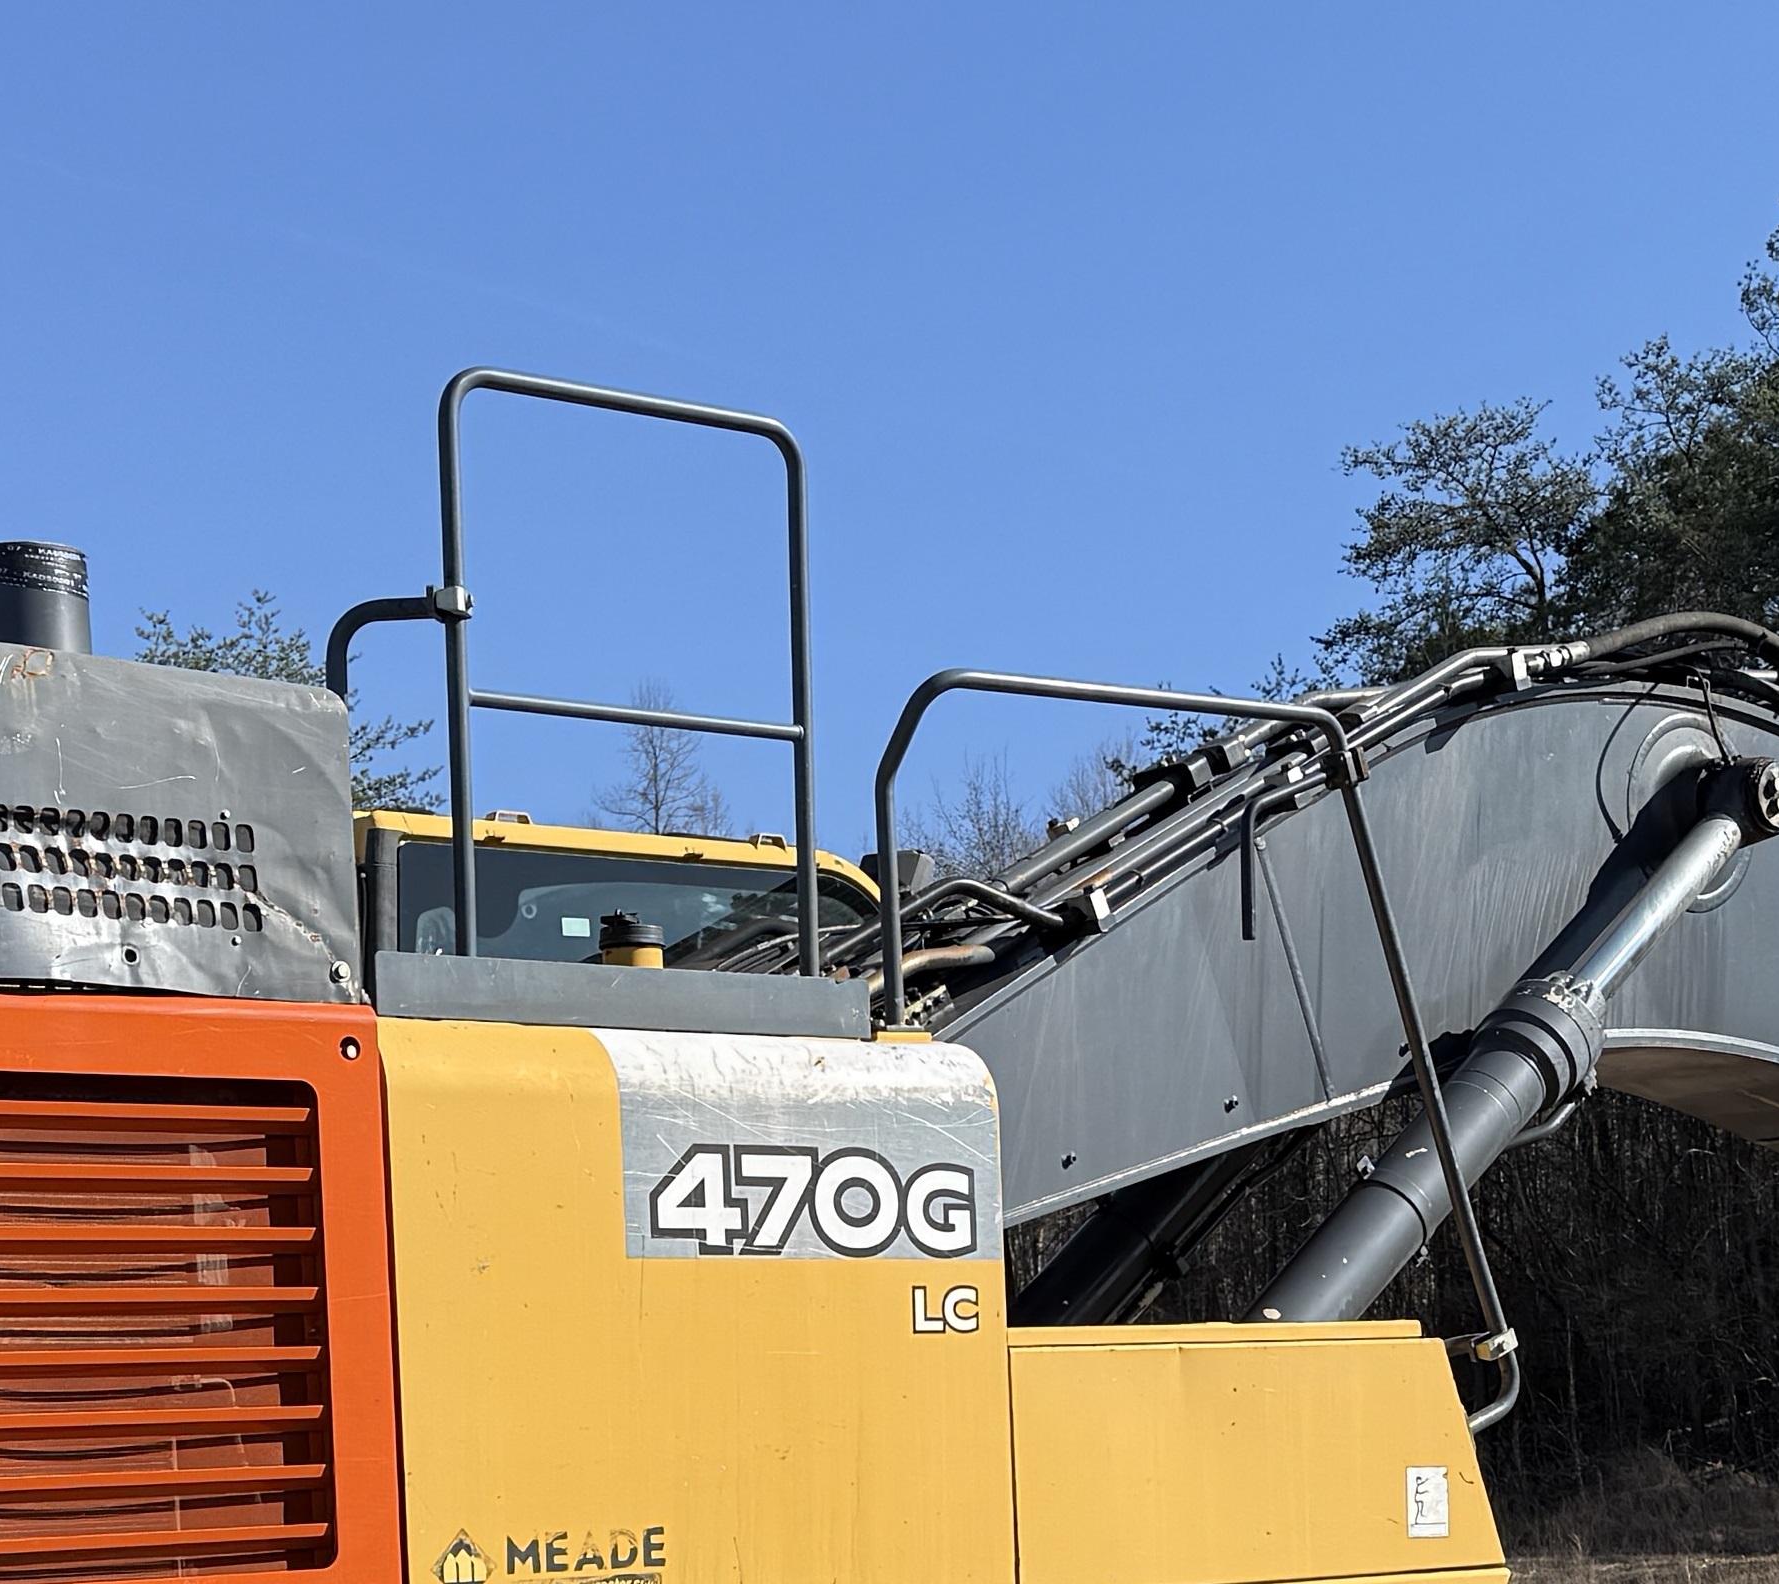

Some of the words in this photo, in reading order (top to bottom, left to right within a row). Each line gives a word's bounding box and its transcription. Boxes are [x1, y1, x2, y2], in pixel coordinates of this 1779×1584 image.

[650, 1144, 978, 1258] 470G
[912, 1286, 979, 1334] LC
[506, 1526, 666, 1575] MEADE
